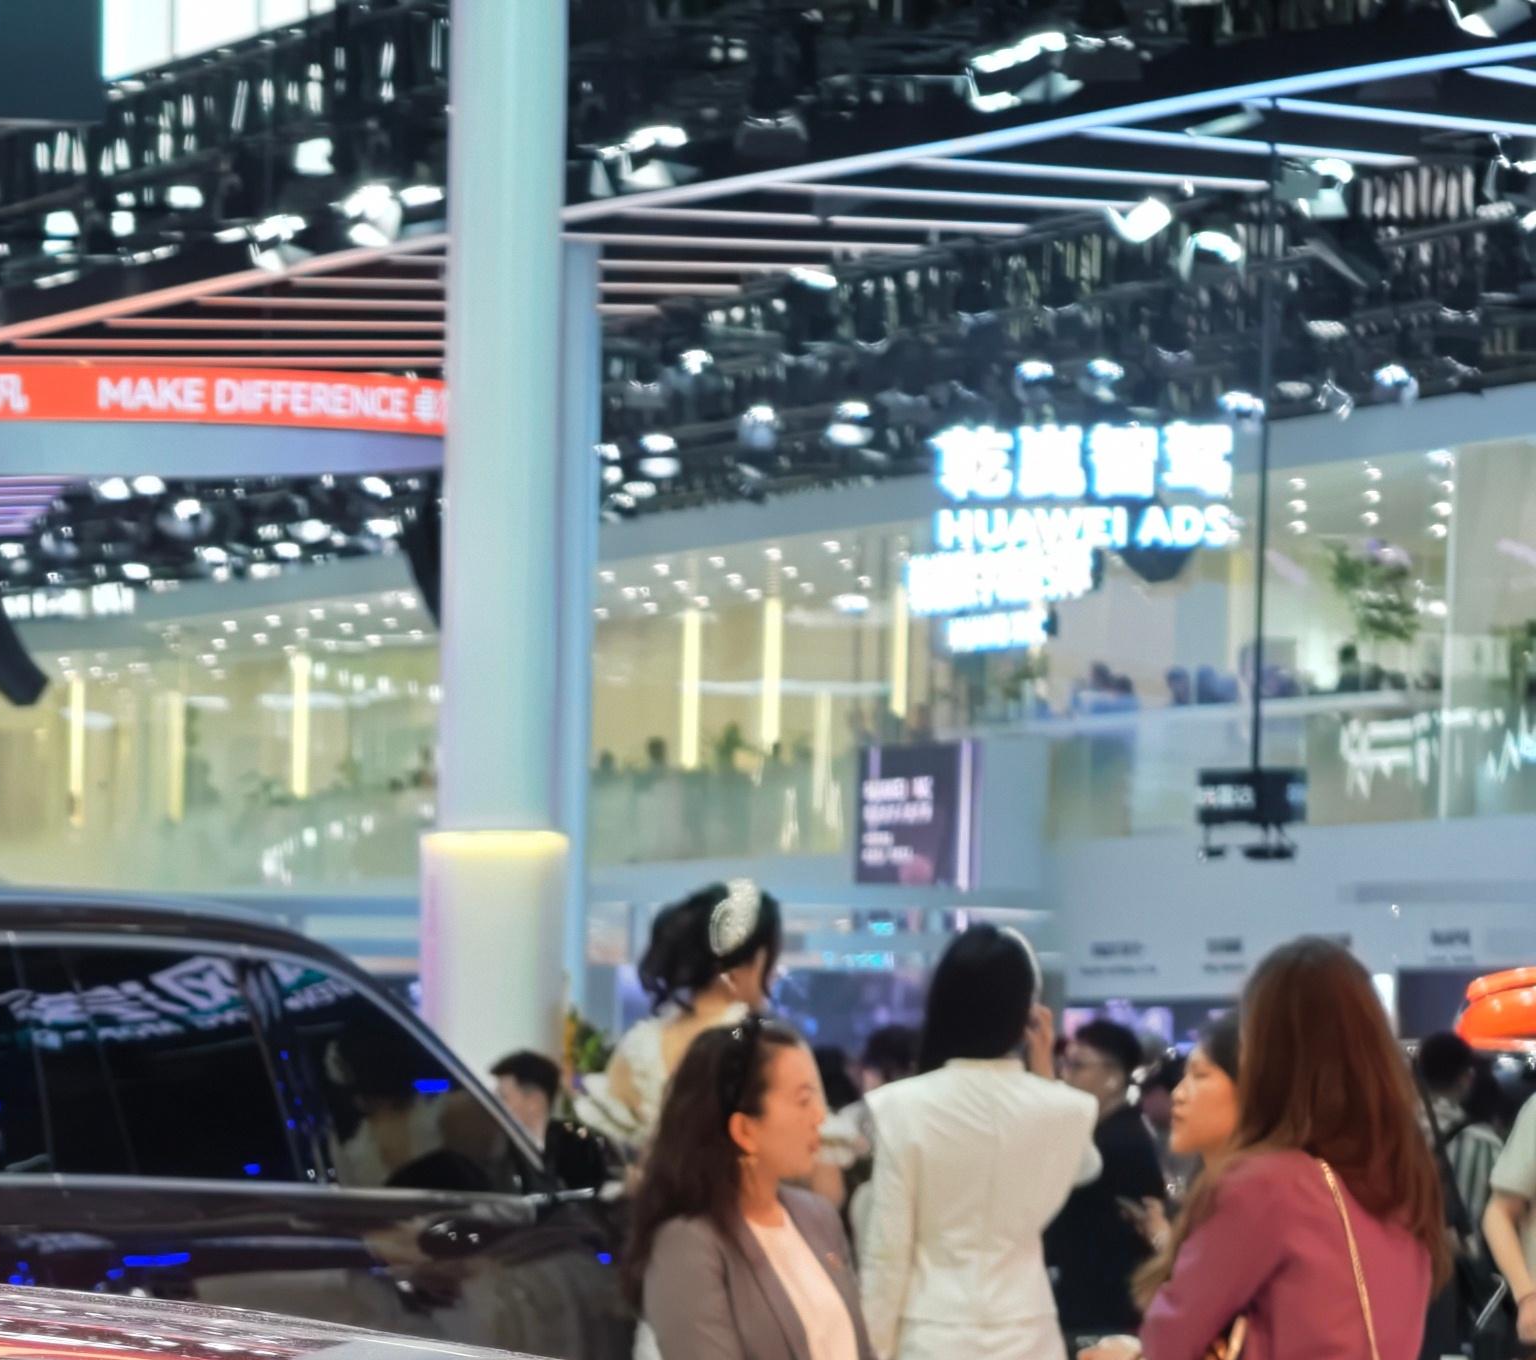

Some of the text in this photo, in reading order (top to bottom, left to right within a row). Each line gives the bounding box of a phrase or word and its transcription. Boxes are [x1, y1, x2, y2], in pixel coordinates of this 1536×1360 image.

[98, 377, 408, 420] MAKE DIFFERENCE
[936, 504, 1232, 549] HUAWEI ADS
